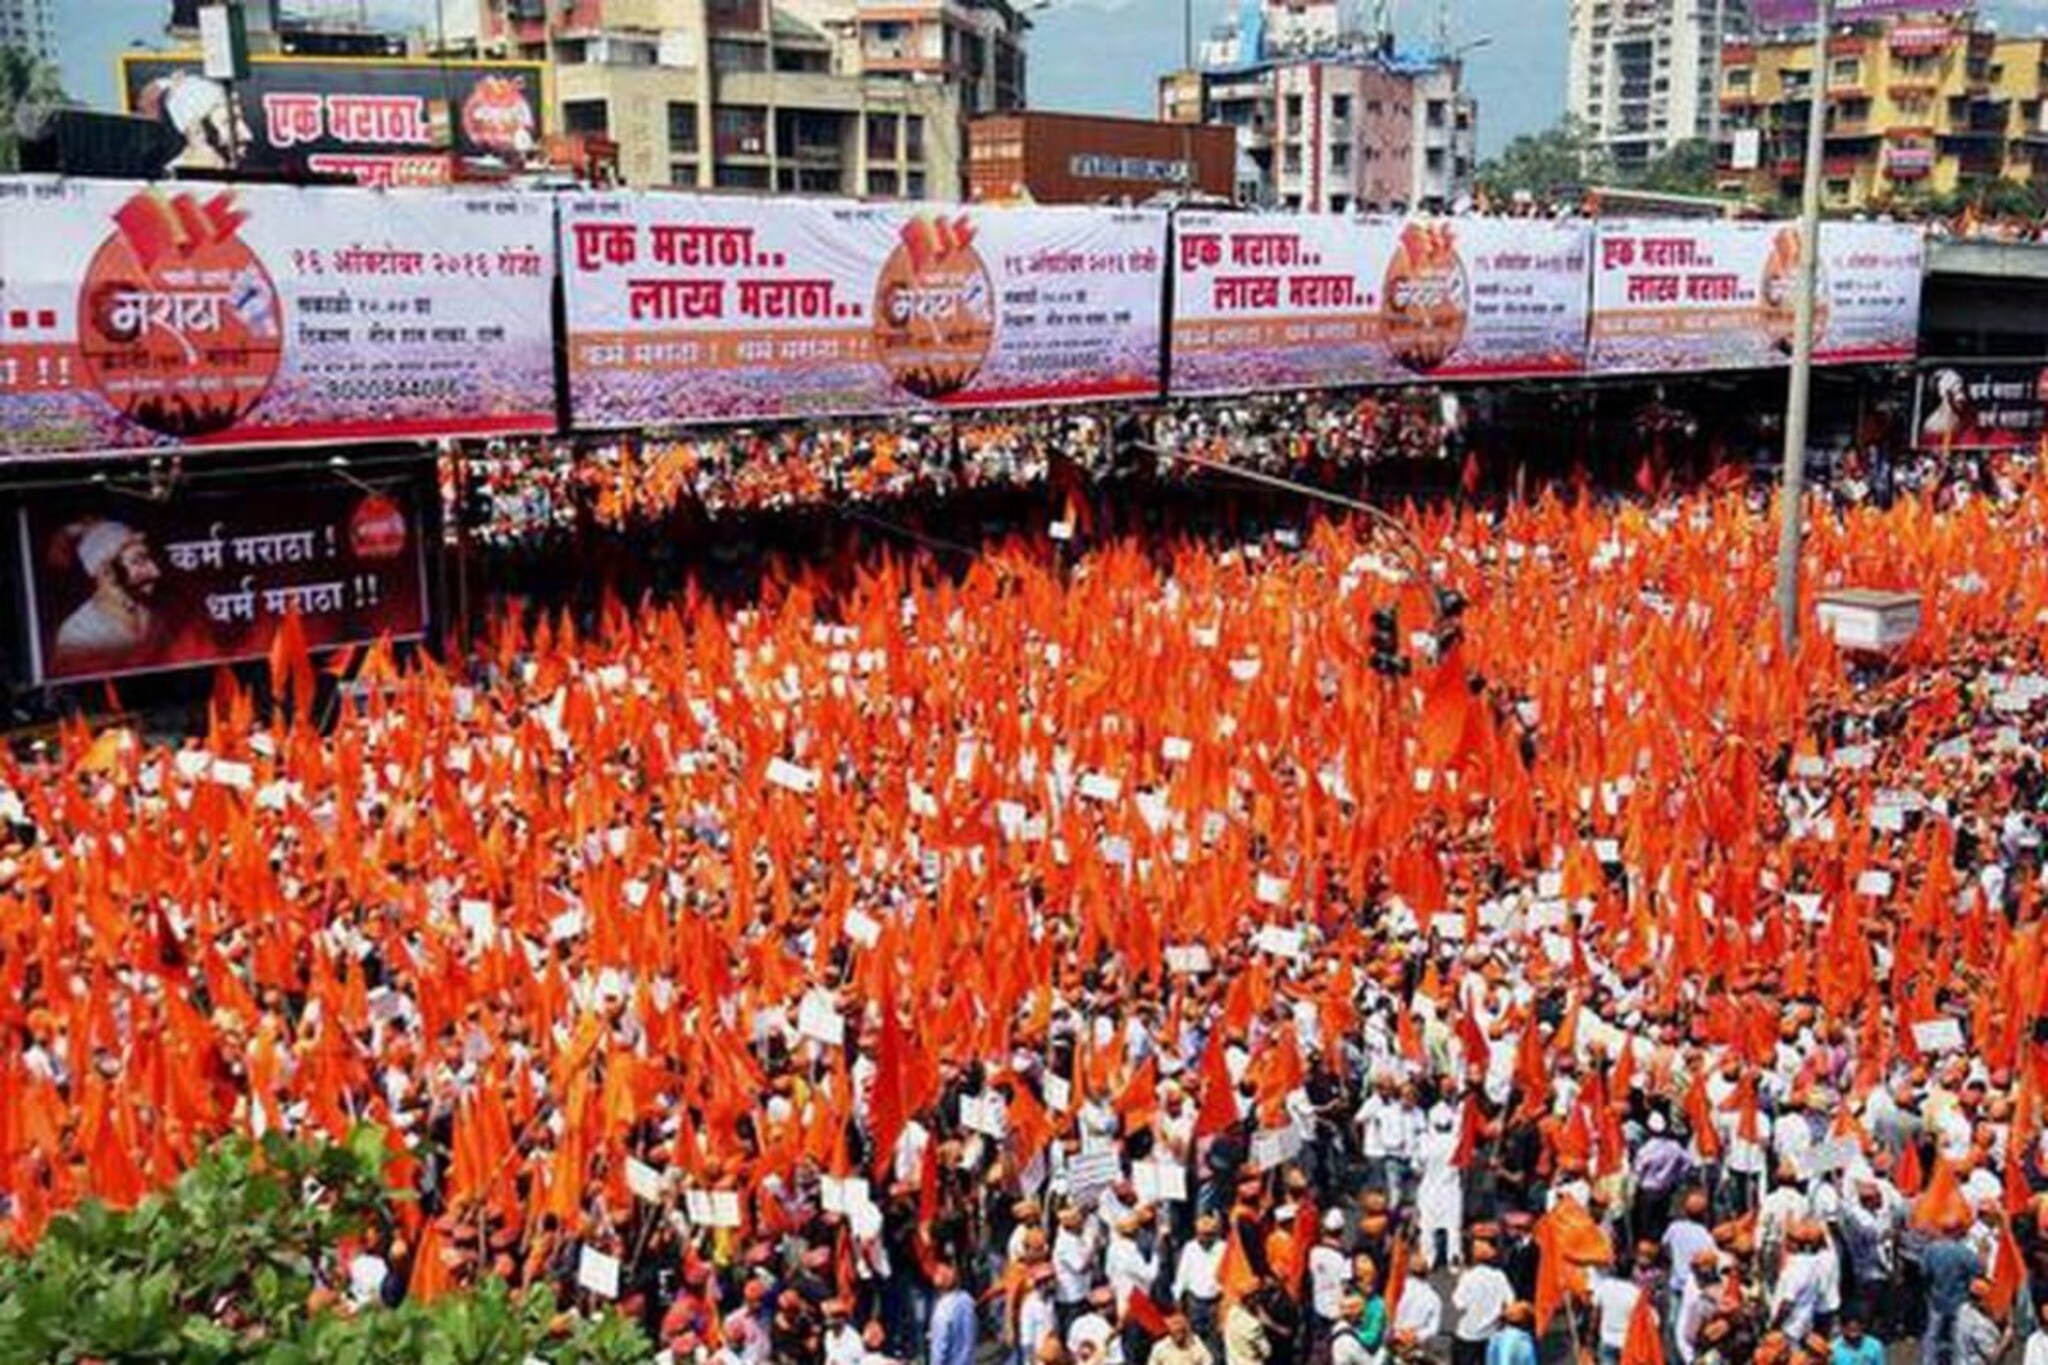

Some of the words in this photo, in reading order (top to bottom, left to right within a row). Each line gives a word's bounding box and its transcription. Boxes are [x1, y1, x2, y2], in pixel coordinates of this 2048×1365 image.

[264, 93, 322, 147] एक
[573, 223, 637, 271] एक
[1180, 234, 1222, 271] एक
[1602, 239, 1635, 270] एक
[628, 279, 726, 319] लाख
[1213, 276, 1280, 310] लाख
[1628, 274, 1680, 301] लाख
[166, 522, 224, 571] कर्म
[234, 530, 315, 566] मराठा
[206, 574, 254, 622] धर्म
[263, 581, 344, 615] मराठा
